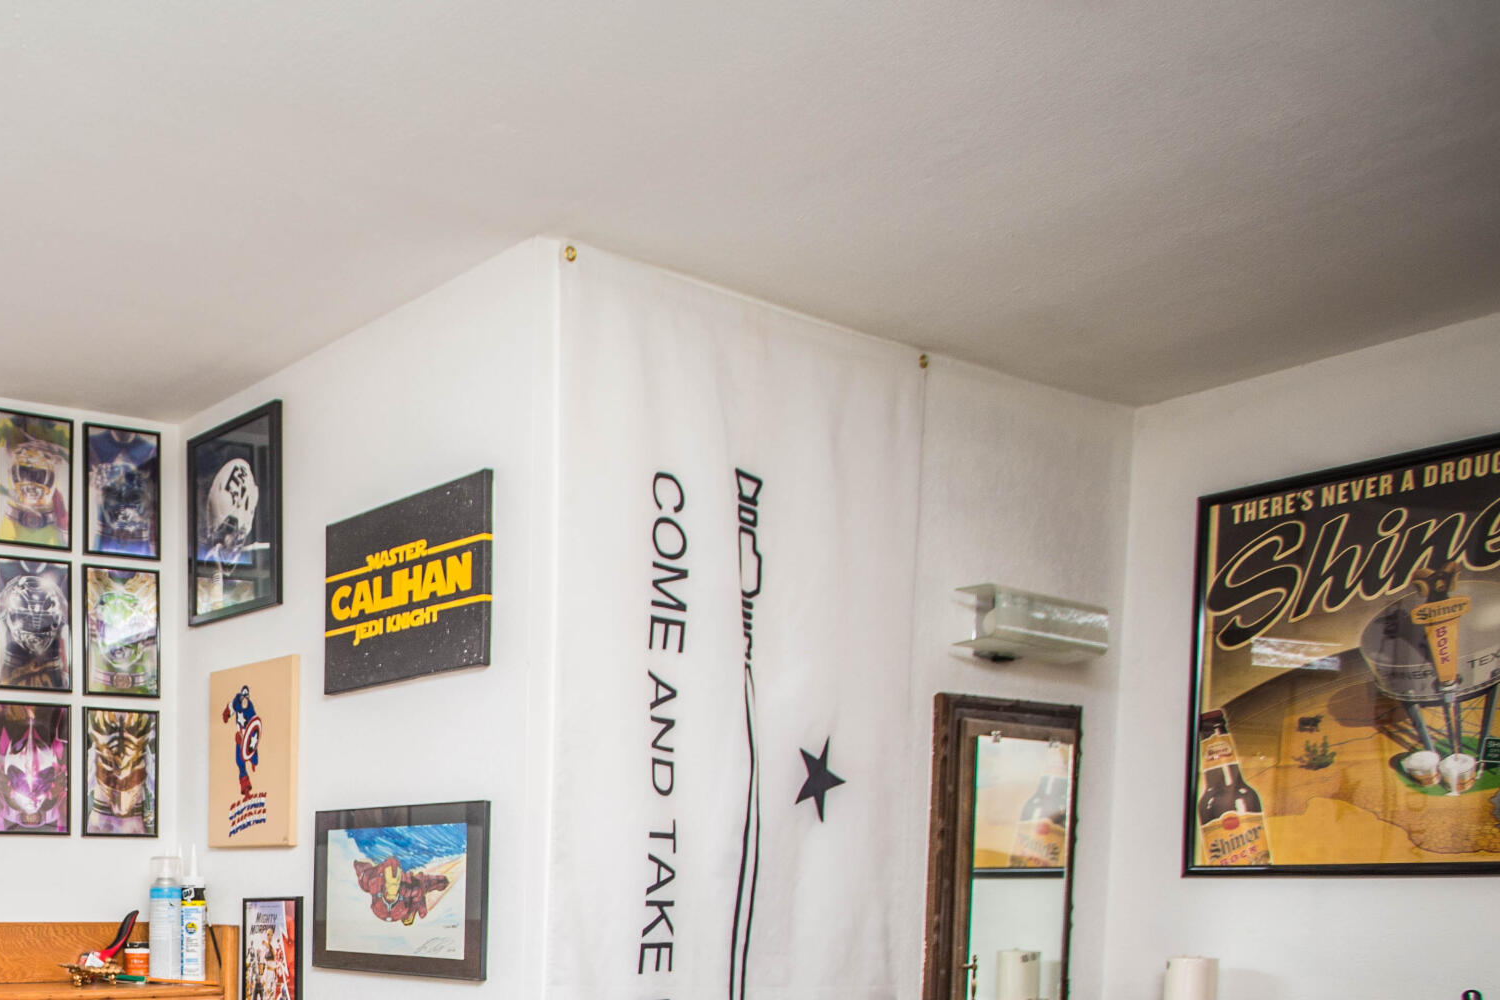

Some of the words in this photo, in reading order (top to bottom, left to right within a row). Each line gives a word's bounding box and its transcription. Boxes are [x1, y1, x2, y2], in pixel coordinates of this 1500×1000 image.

[1232, 489, 1315, 525] THERE'S
[1321, 473, 1394, 508] NEVER
[1400, 469, 1415, 492] A
[366, 538, 428, 571] MASTER
[649, 471, 689, 653] COME
[353, 617, 384, 647] JEDI
[386, 607, 440, 633] KNIGHT
[1416, 601, 1469, 621] Shiner
[1435, 625, 1451, 665] BOCK
[647, 669, 678, 796] AND
[1209, 825, 1263, 862] Shiner
[638, 819, 676, 974] TAKE
[256, 912, 278, 924] MIGHTY
